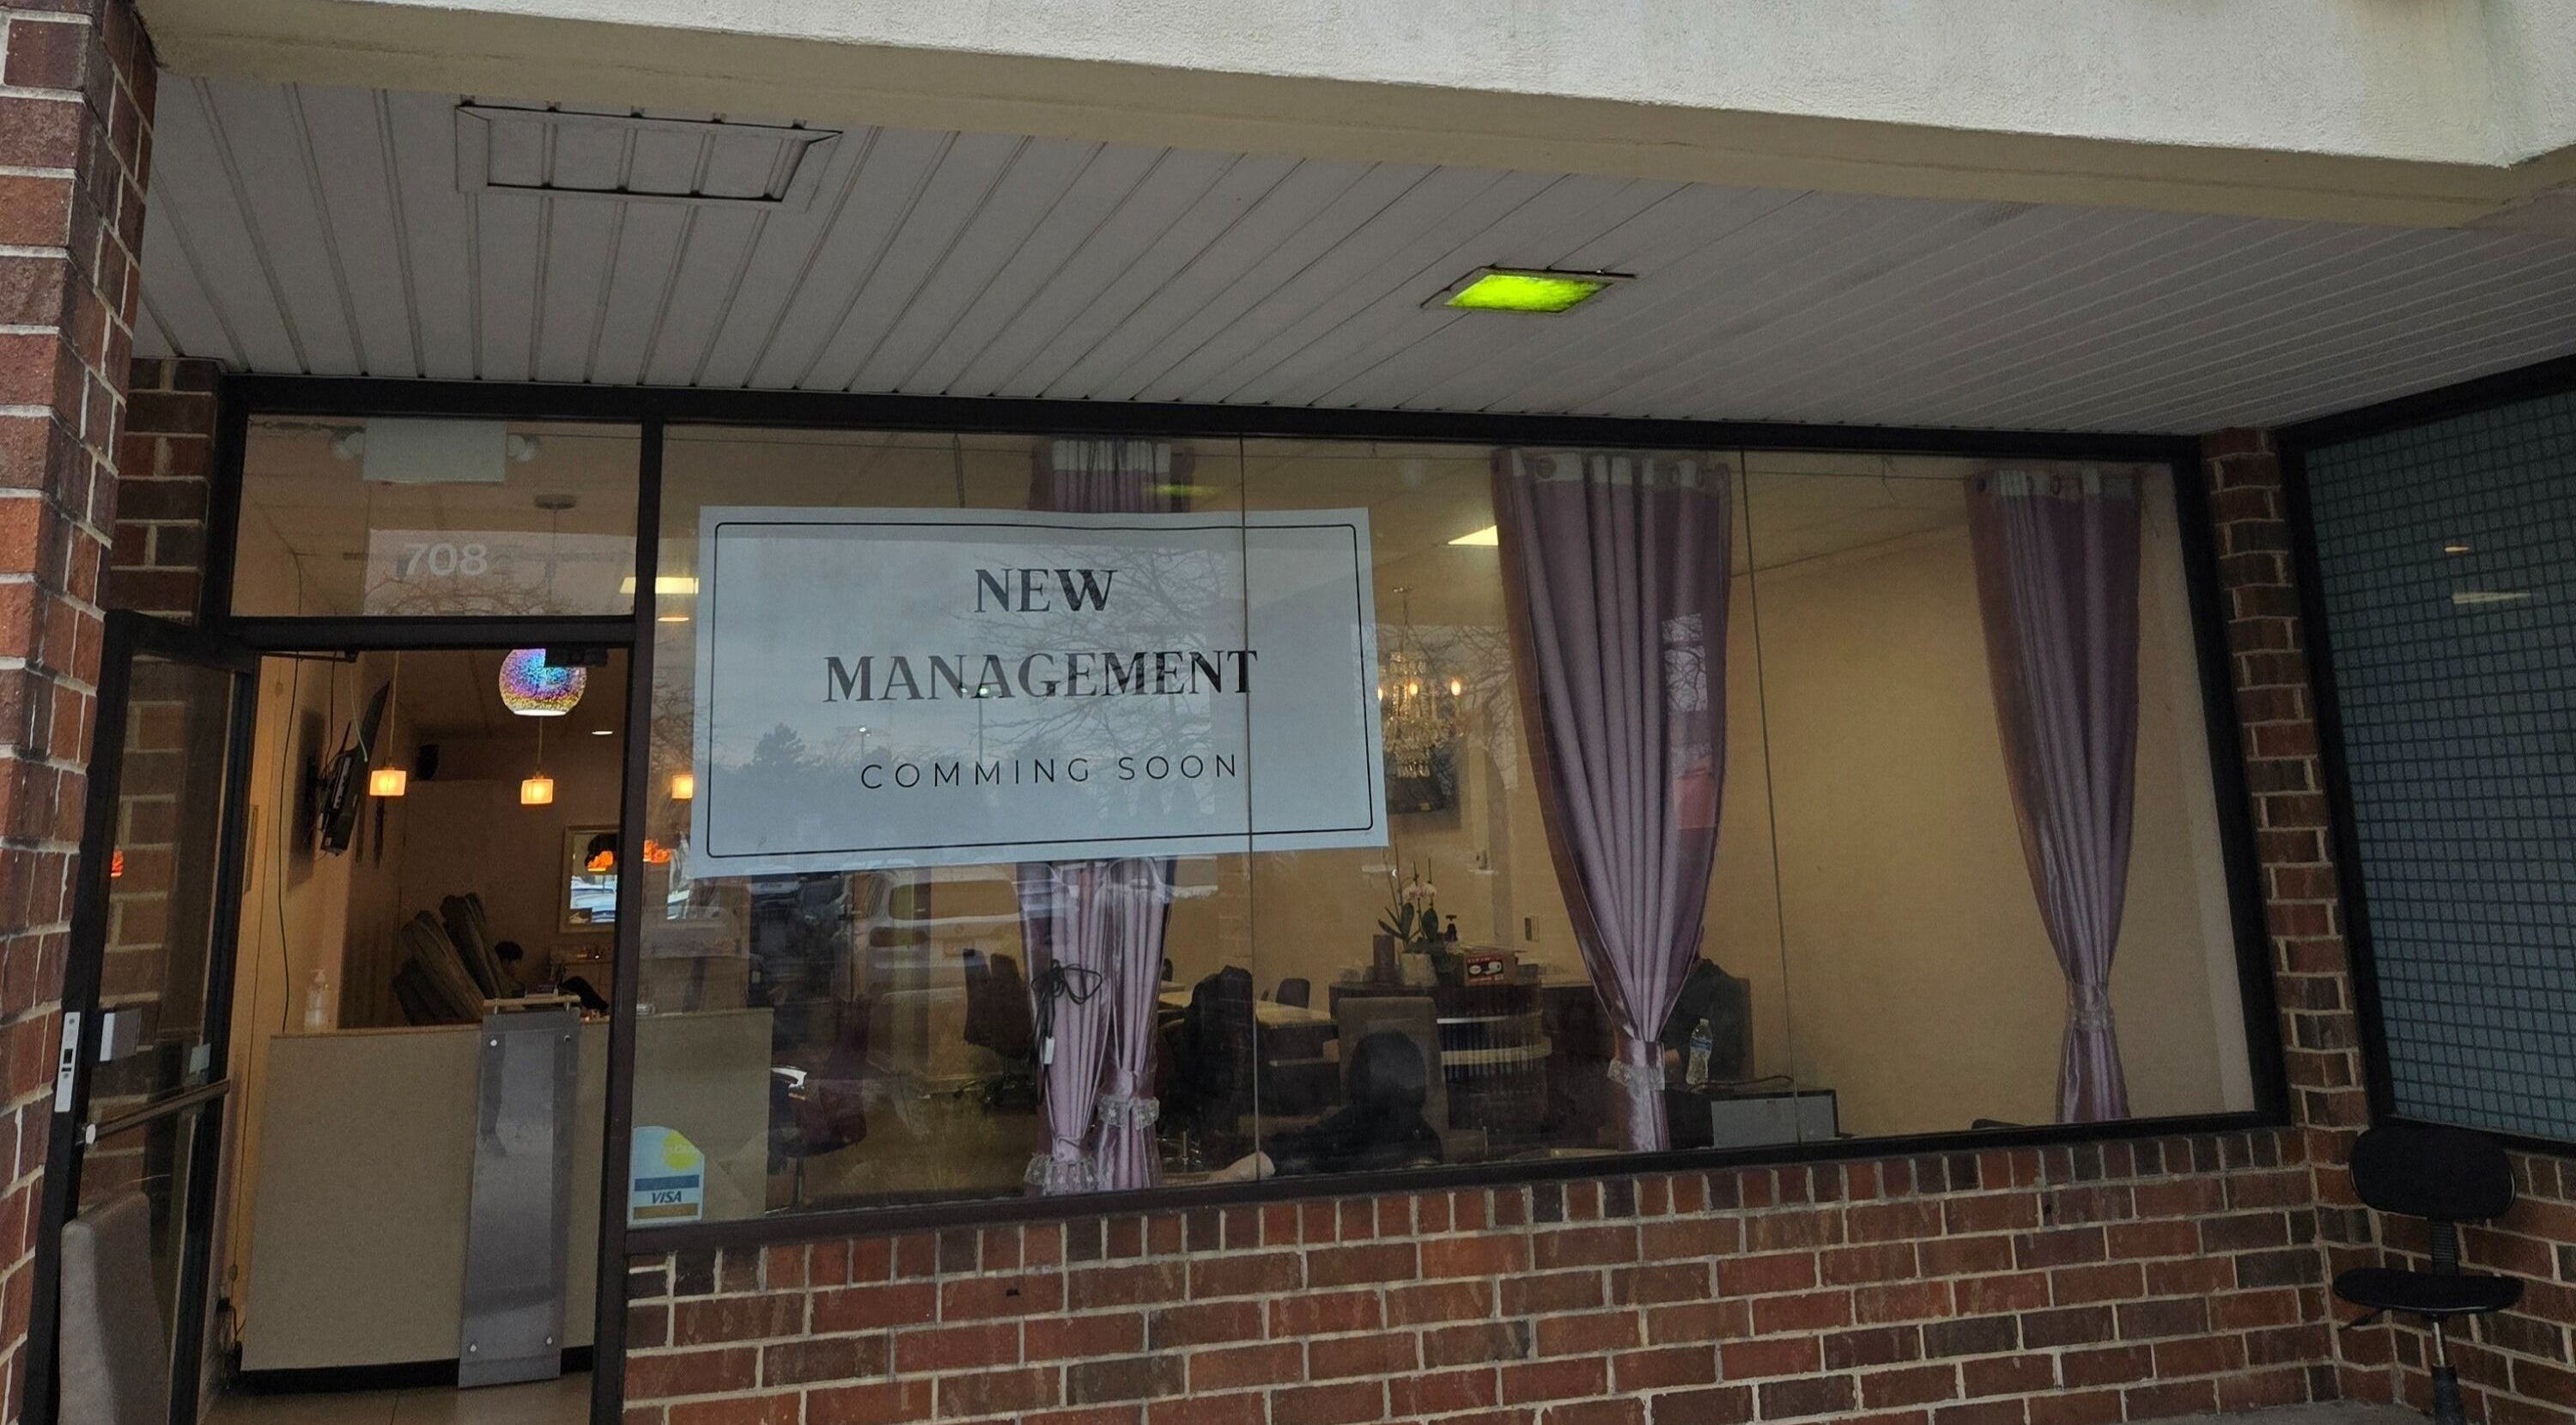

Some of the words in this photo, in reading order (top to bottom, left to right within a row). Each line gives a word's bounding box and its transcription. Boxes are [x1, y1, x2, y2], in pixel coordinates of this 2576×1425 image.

[404, 542, 488, 576] 708
[975, 569, 1117, 613] NEW
[823, 650, 1258, 702] MANAGEMENT
[860, 758, 1091, 789] COMMING
[1118, 753, 1236, 781] SOON
[652, 1191, 682, 1204] VISA
